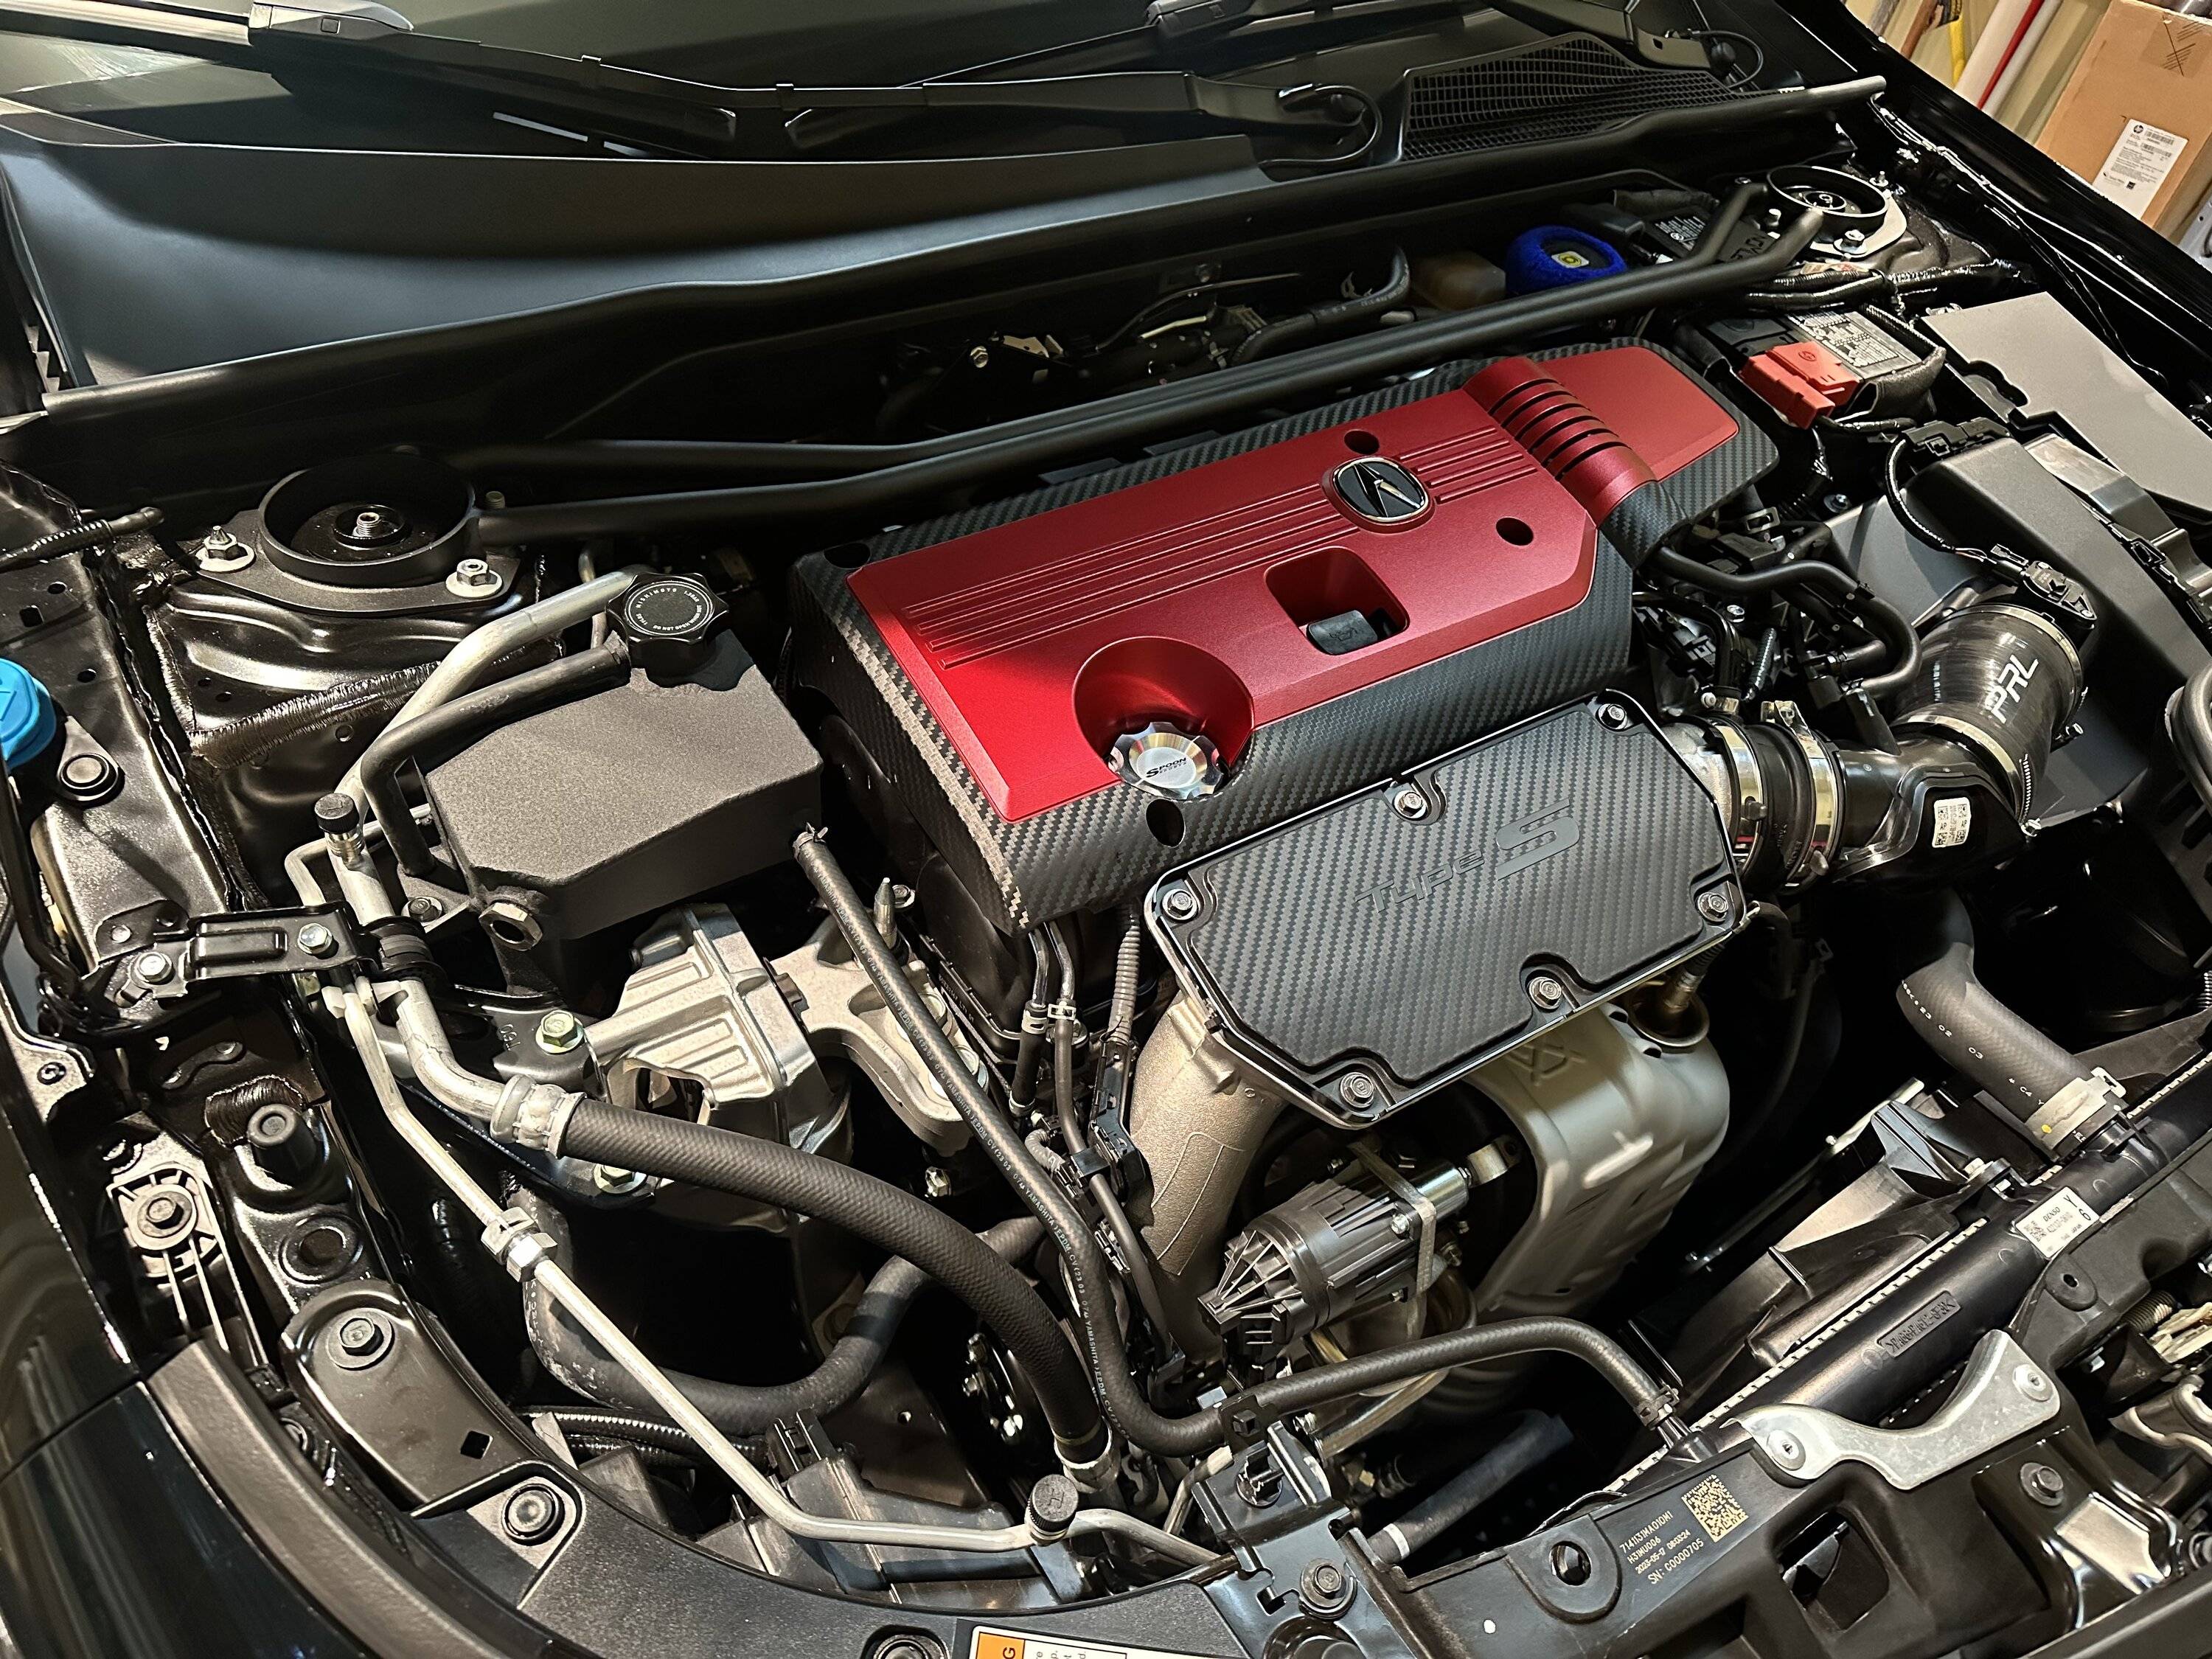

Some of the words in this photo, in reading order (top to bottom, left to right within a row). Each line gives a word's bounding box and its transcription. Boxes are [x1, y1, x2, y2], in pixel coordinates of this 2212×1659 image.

[636, 588, 677, 608] MISHIMOTO
[1986, 655, 2039, 724] PRL
[1146, 757, 1186, 778] SPOON
[1495, 797, 1580, 881] S
[1938, 1023, 1952, 1037] 02
[1968, 1047, 1983, 1060] 03
[877, 971, 898, 1007] YAMASHITA
[945, 1078, 971, 1116] YAMASHITA
[1025, 1187, 1056, 1226] YAMASHITA
[1085, 1321, 1099, 1364] YAMASHITA
[2063, 1194, 2077, 1208] Y
[2043, 1207, 2061, 1222] DENSO
[2079, 1208, 2091, 1221] 6
[1635, 1548, 1666, 1574] 2023-05-17
[1648, 1568, 1665, 1585] SN:
